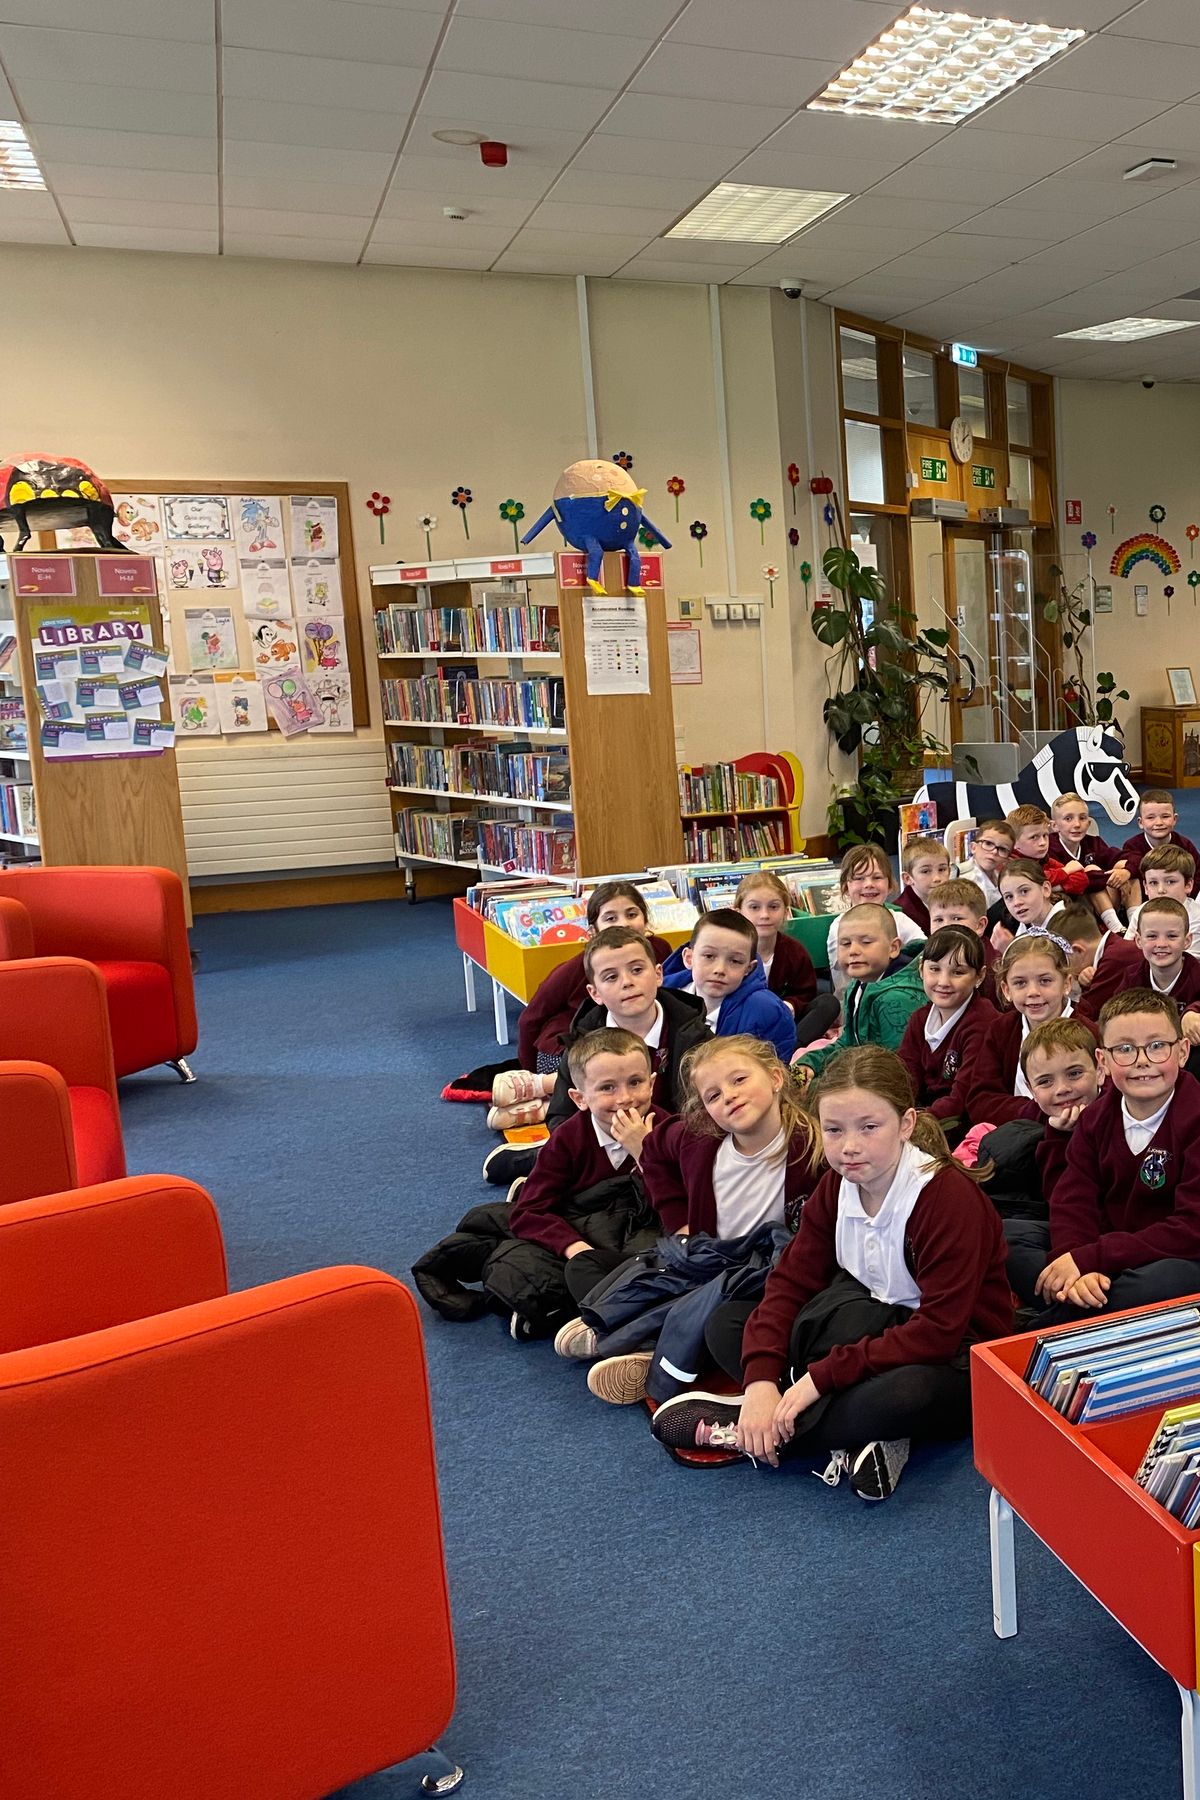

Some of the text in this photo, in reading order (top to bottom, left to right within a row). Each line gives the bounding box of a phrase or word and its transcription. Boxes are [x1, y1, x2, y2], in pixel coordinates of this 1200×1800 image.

[922, 460, 933, 469] FIRE
[922, 470, 933, 479] EXIT
[972, 467, 982, 475] FIRE
[973, 476, 982, 485] EXIT
[41, 622, 140, 644] LIBRARY
